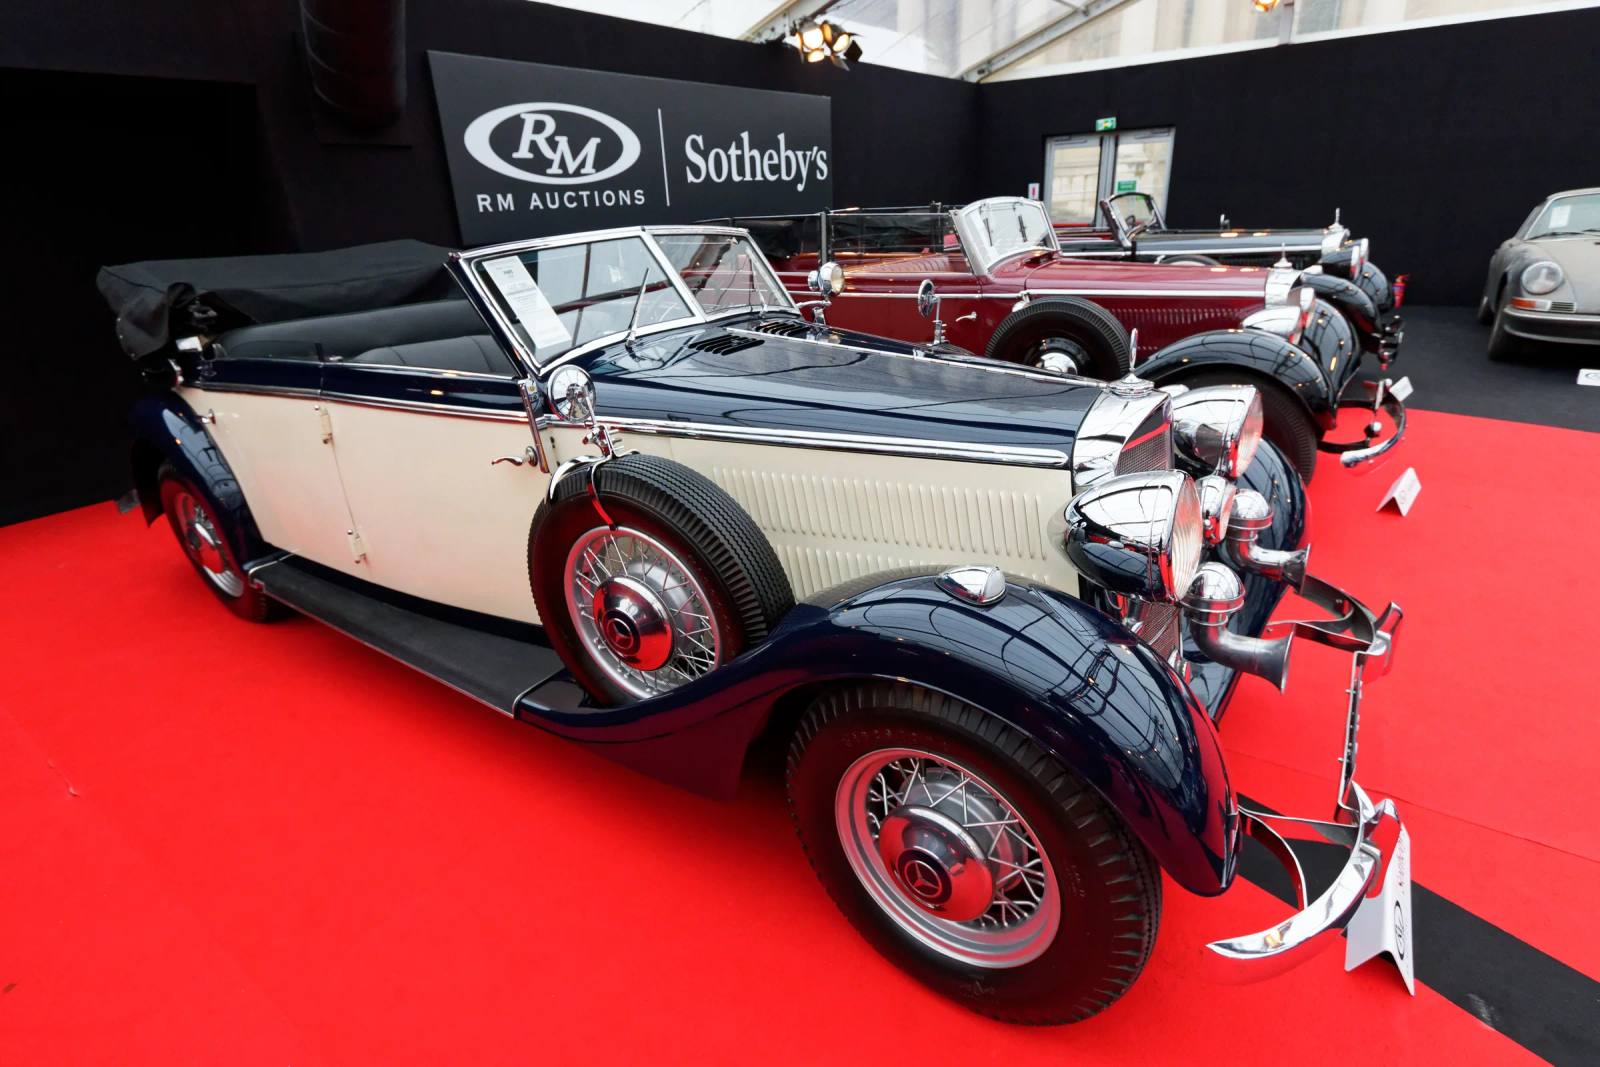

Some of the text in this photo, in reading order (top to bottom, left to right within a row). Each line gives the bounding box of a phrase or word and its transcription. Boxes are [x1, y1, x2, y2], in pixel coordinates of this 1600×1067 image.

[512, 112, 601, 175] RM
[684, 130, 828, 192] Sotheby's
[476, 188, 646, 213] RM AUCTIONS
